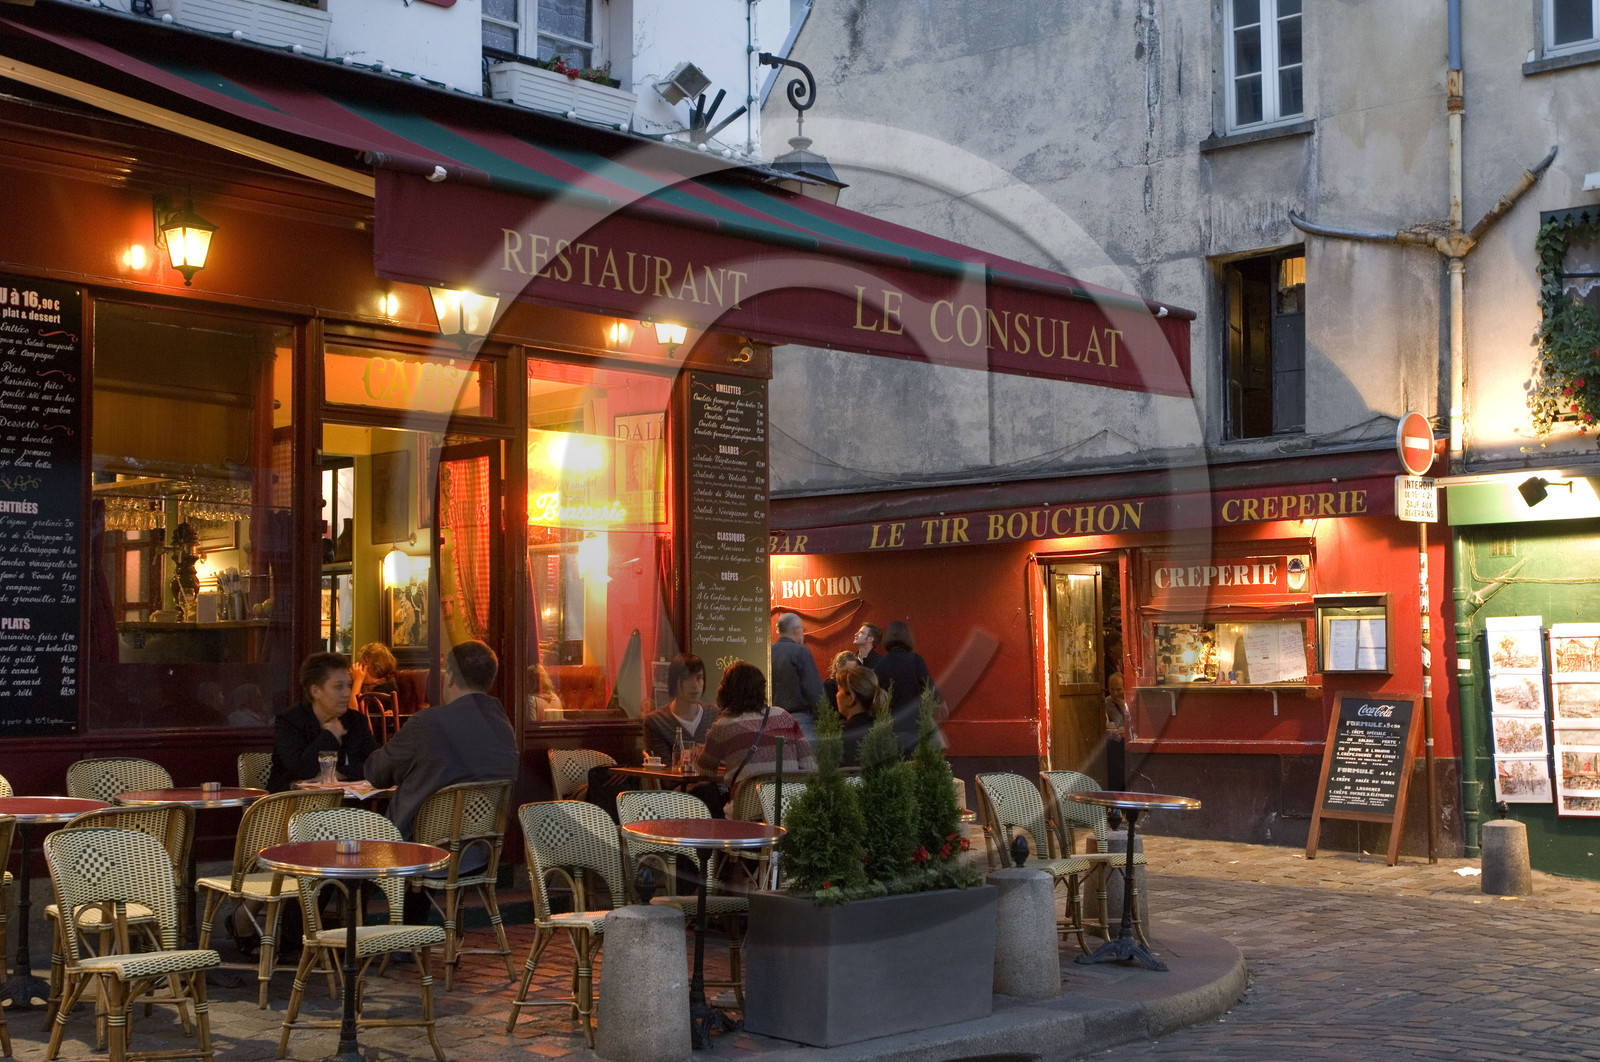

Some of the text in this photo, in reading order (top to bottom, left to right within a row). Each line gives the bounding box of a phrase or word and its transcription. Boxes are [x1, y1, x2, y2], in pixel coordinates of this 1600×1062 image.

[501, 228, 749, 311] RESTAURANT
[10, 288, 20, 306] à
[2, 307, 61, 325] plat & dessert
[0, 322, 29, 334] Entrées
[853, 284, 1123, 369] LE CONSULAT
[25, 338, 45, 347] Salade
[47, 343, 74, 355] composée
[8, 347, 16, 355] de
[21, 350, 55, 362] Campagne
[1, 361, 26, 374] Plats
[43, 380, 64, 391] frites
[362, 357, 459, 407] CAFÉ
[716, 383, 742, 396] OMELETTES
[0, 389, 25, 400] poulet
[54, 393, 75, 403] herbes
[693, 392, 712, 403] Omelette
[704, 403, 722, 412] Omelette
[0, 415, 39, 429] Desserts
[704, 412, 723, 421] Omelette
[617, 414, 664, 441] DALÍ
[699, 419, 718, 428] Omelette
[694, 428, 713, 437] Omelette
[22, 434, 53, 444] chocolat
[21, 449, 51, 459] pommes
[719, 445, 740, 456] SALADES
[14, 459, 33, 468] blanc
[693, 453, 713, 462] Salade
[693, 470, 714, 479] Salade
[1405, 480, 1433, 490] INTERDIT
[693, 488, 713, 497] Salade
[0, 499, 39, 514] ENTRÉES
[531, 492, 626, 521] Brasserie
[693, 506, 713, 514] Salade
[1222, 489, 1369, 524] CREPERIE
[1406, 500, 1419, 508] SAUF
[1405, 508, 1434, 518] RIVERAINS
[32, 518, 62, 529] gratinée
[868, 501, 1145, 550] LE TIR BOUCHON
[23, 529, 63, 545] Bourgogne
[717, 531, 746, 543] CLASSIQUES
[20, 542, 59, 557] Bourgogne
[696, 540, 745, 552] Croque Monsieur
[770, 535, 809, 553] BAR
[695, 551, 719, 563] Lasagnes
[32, 571, 55, 580] Toasts
[721, 570, 739, 581] CRÊPES
[1154, 563, 1278, 589] CREPERIE
[6, 585, 41, 594] campagne
[781, 575, 863, 599] BOUCHON
[12, 594, 55, 606] grenouilles
[2, 617, 31, 630] PLATS
[38, 632, 57, 644] frites
[694, 633, 724, 645] Supplément
[726, 634, 748, 645] Chantilly
[45, 645, 63, 653] herbes
[14, 655, 36, 668] grillé
[11, 666, 40, 675] canard
[13, 677, 42, 686] canard
[15, 688, 33, 697] rôti
[8, 718, 22, 726] partir
[1346, 720, 1384, 728] FORMULE
[1337, 767, 1375, 775] FORMULE
